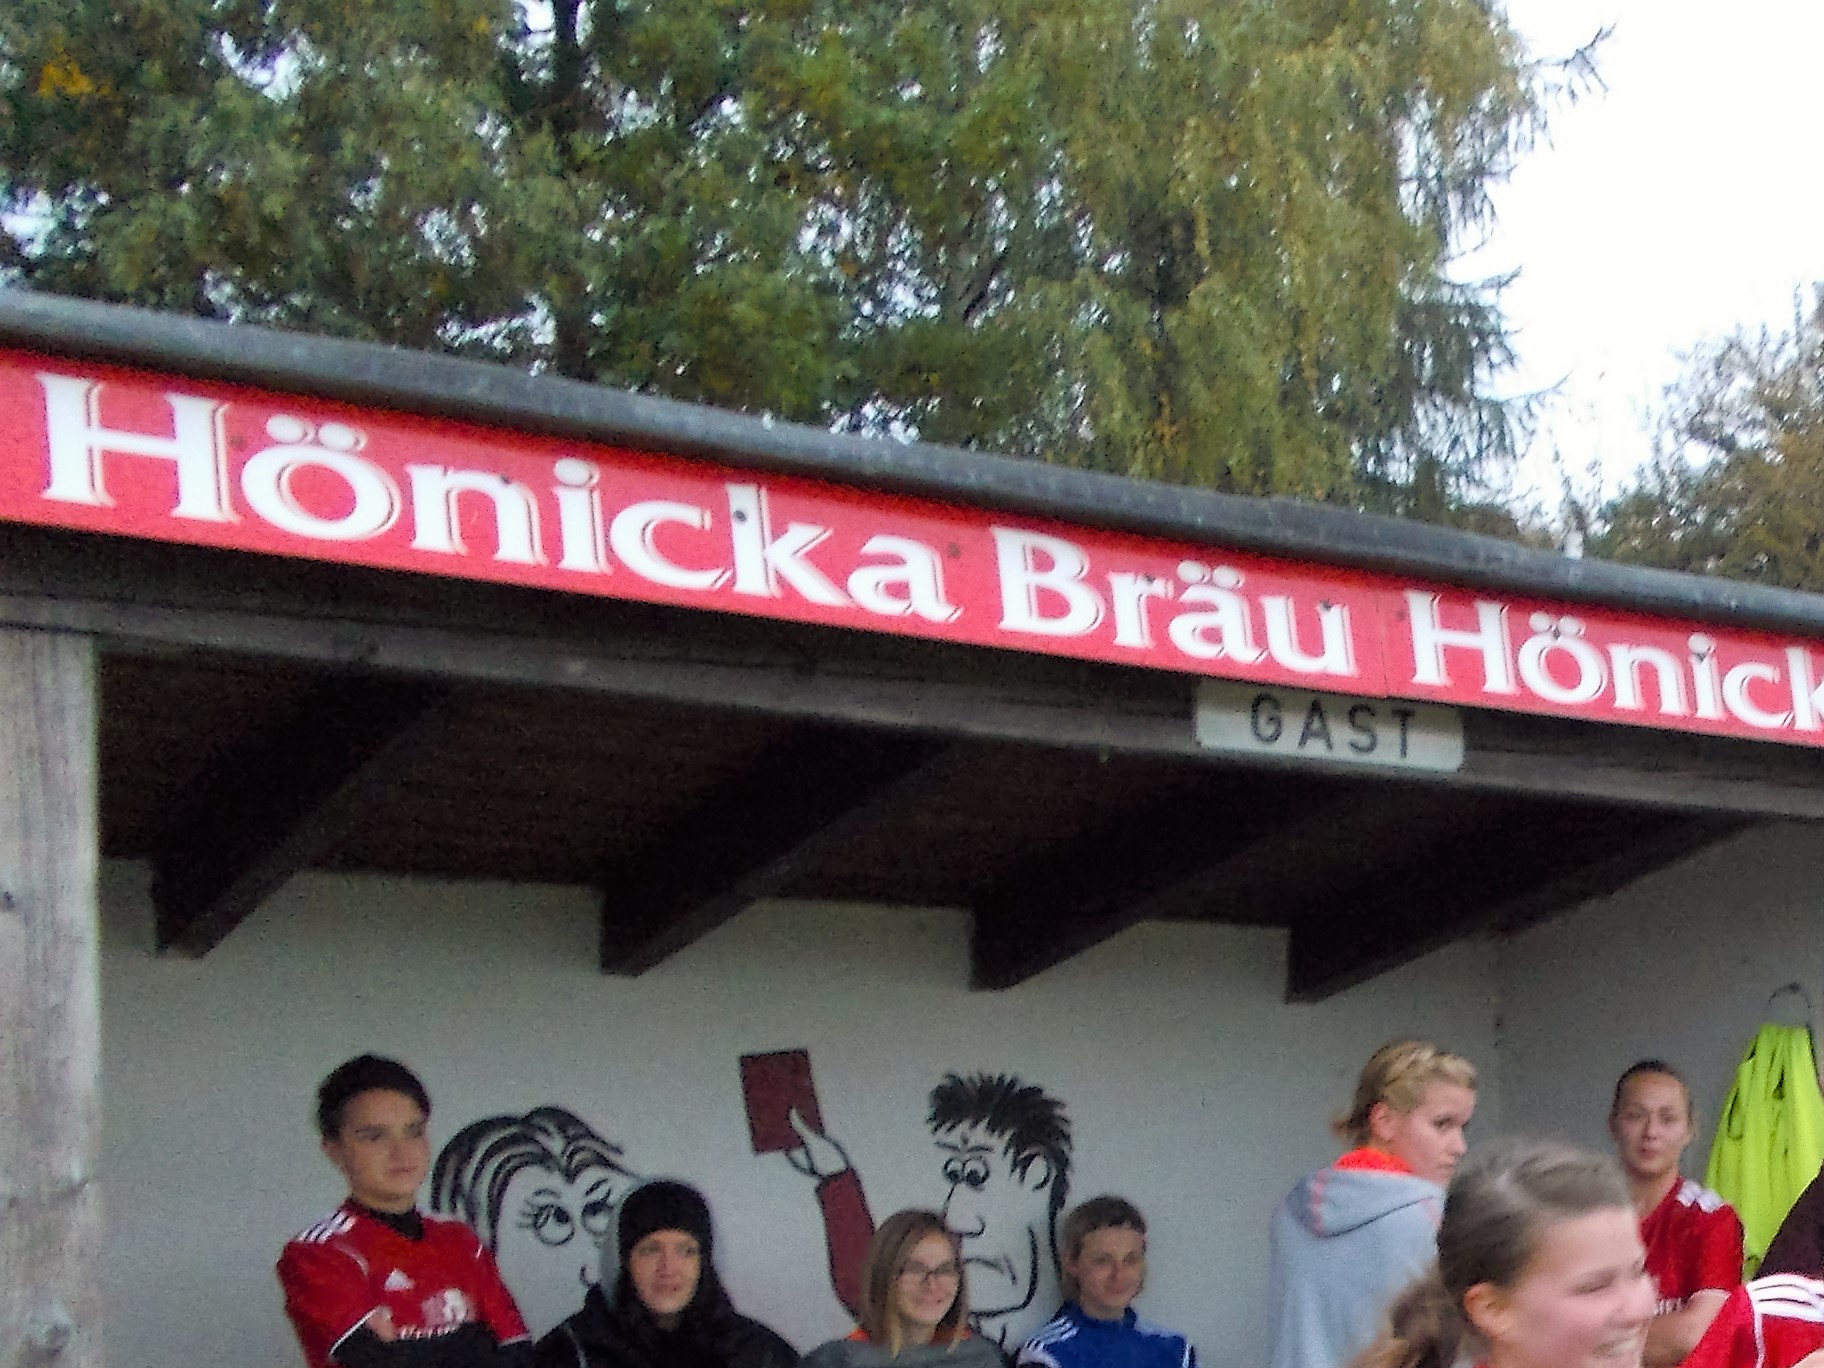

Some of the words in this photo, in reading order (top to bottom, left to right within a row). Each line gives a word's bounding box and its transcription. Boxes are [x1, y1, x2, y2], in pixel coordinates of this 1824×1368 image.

[35, 372, 963, 625] Hönicka
[990, 525, 1358, 677] Bräu
[1250, 692, 1416, 760] GAST
